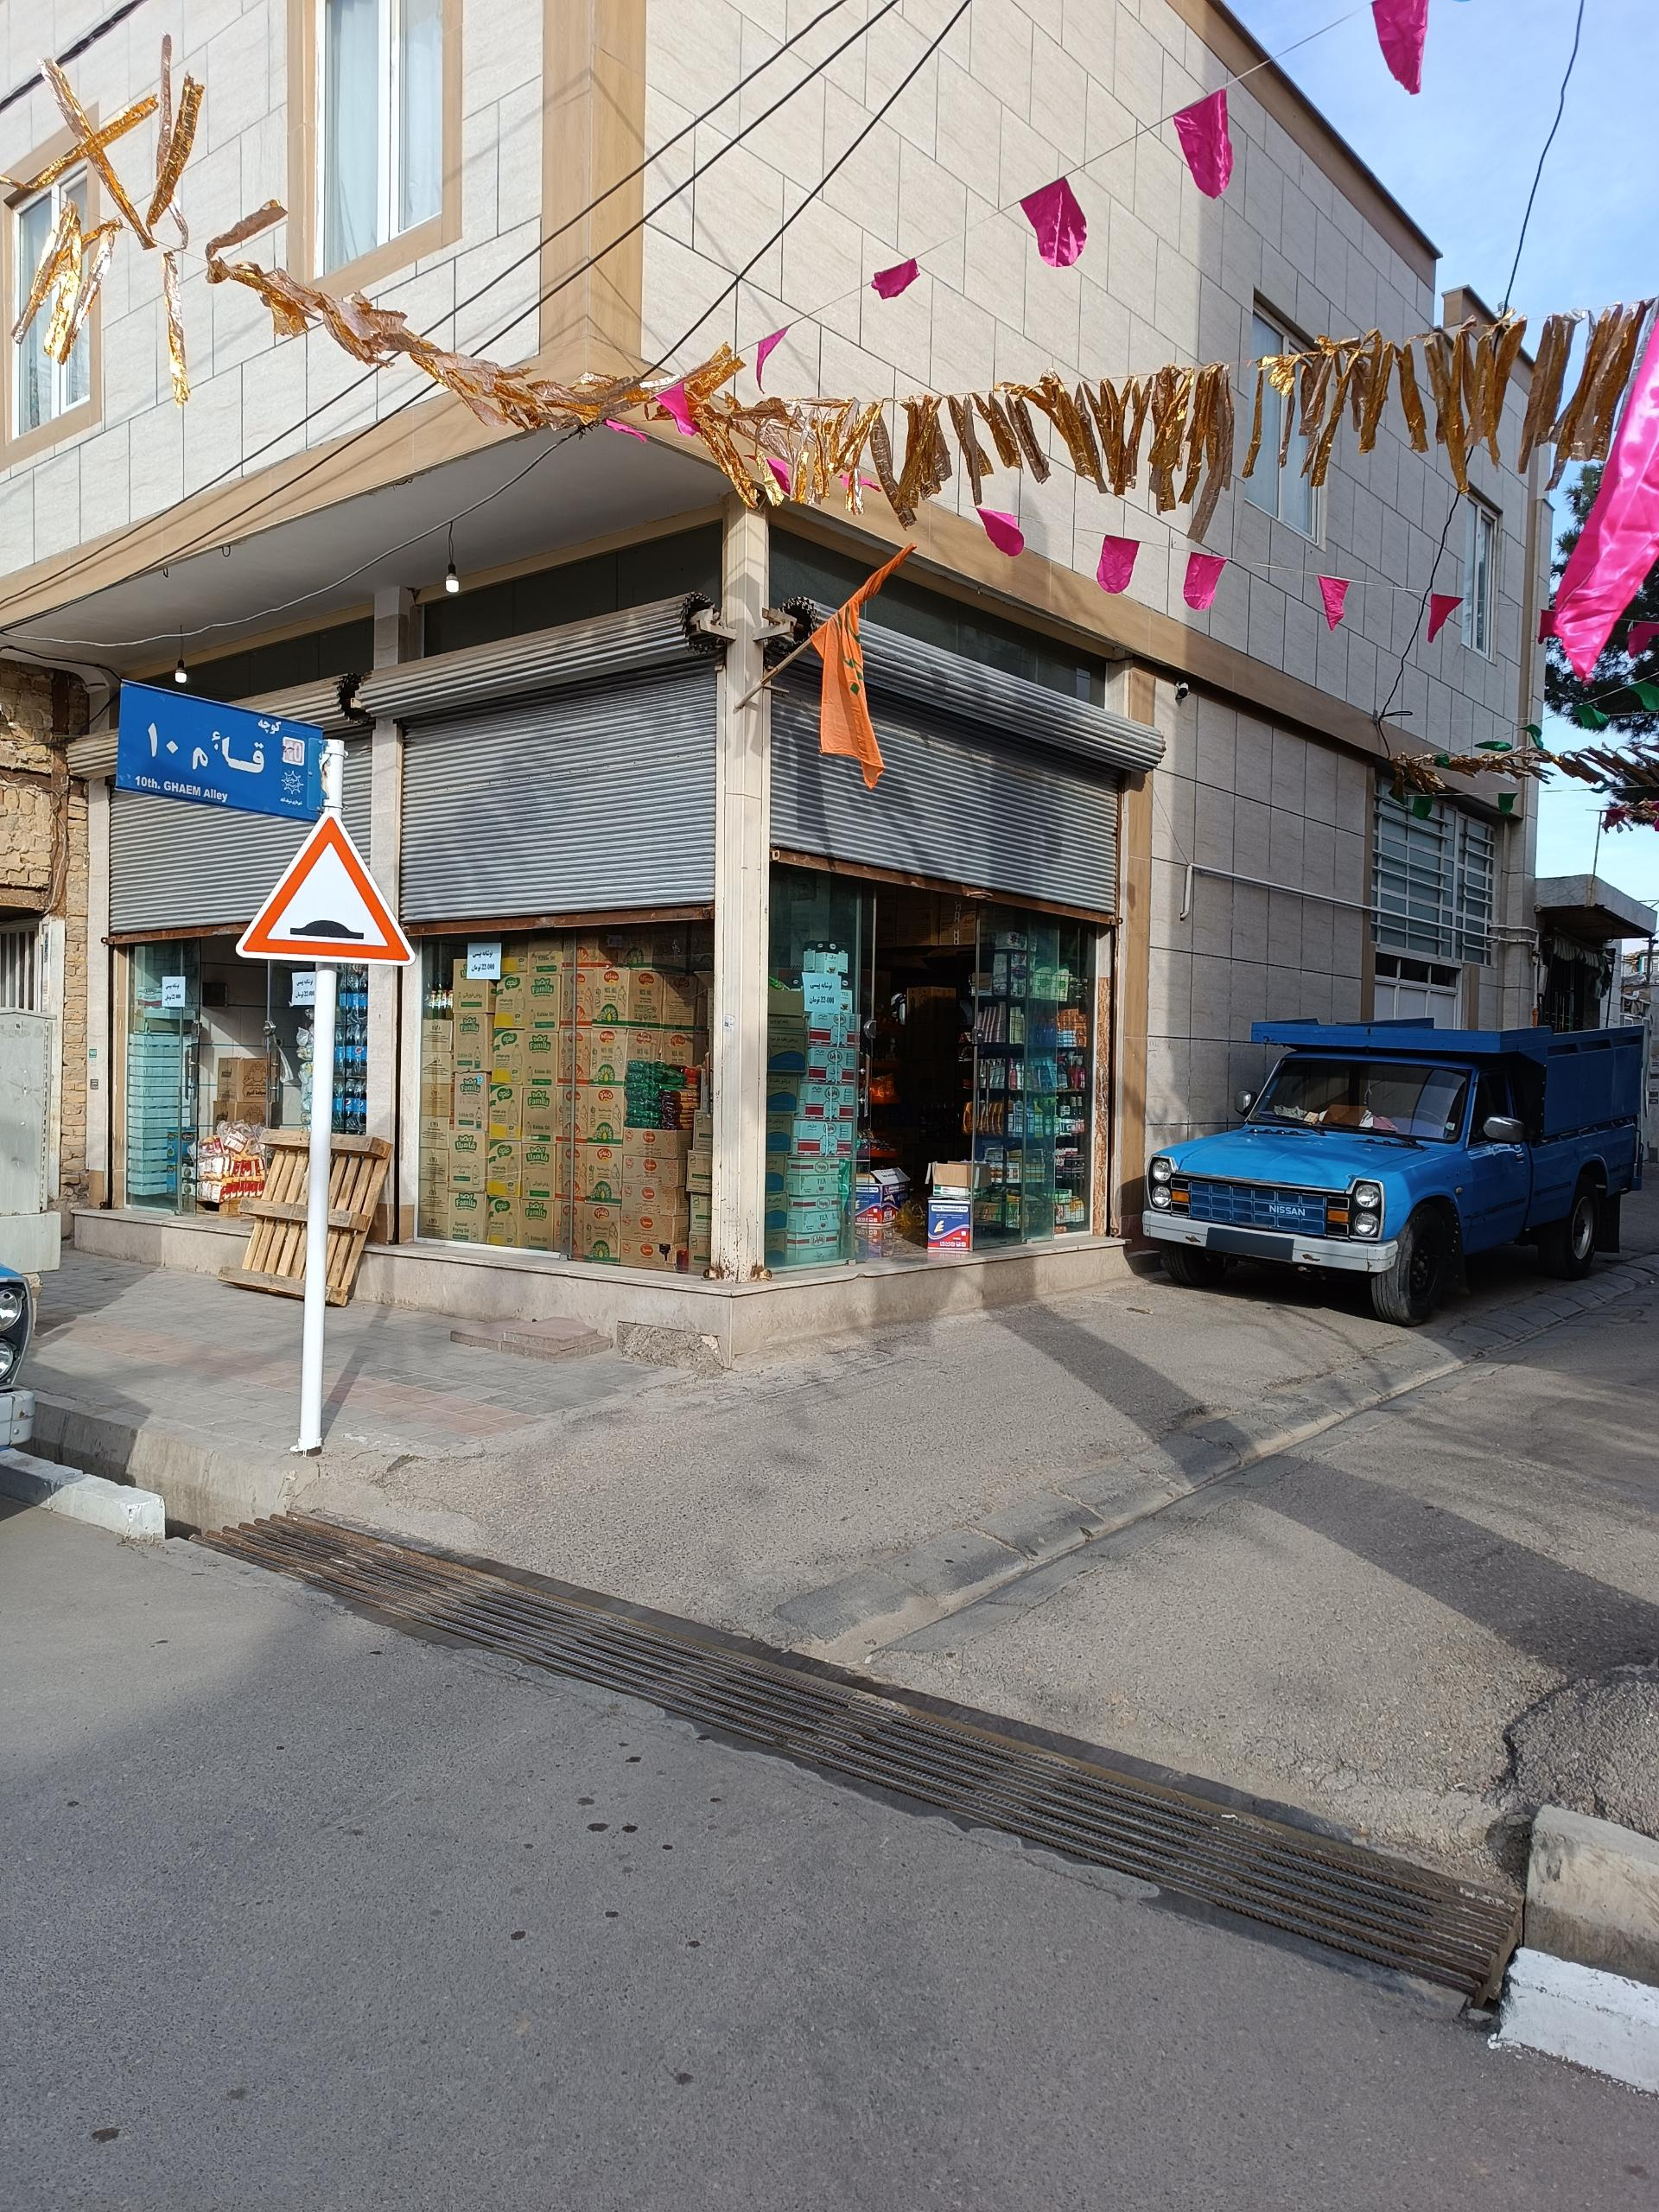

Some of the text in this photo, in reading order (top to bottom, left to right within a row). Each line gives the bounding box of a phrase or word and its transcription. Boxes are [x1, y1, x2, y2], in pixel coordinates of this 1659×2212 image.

[258, 718, 282, 734] کوچه
[135, 775, 228, 803] 10th. GHAEM Alley
[1268, 1205, 1306, 1216] NISSAN
